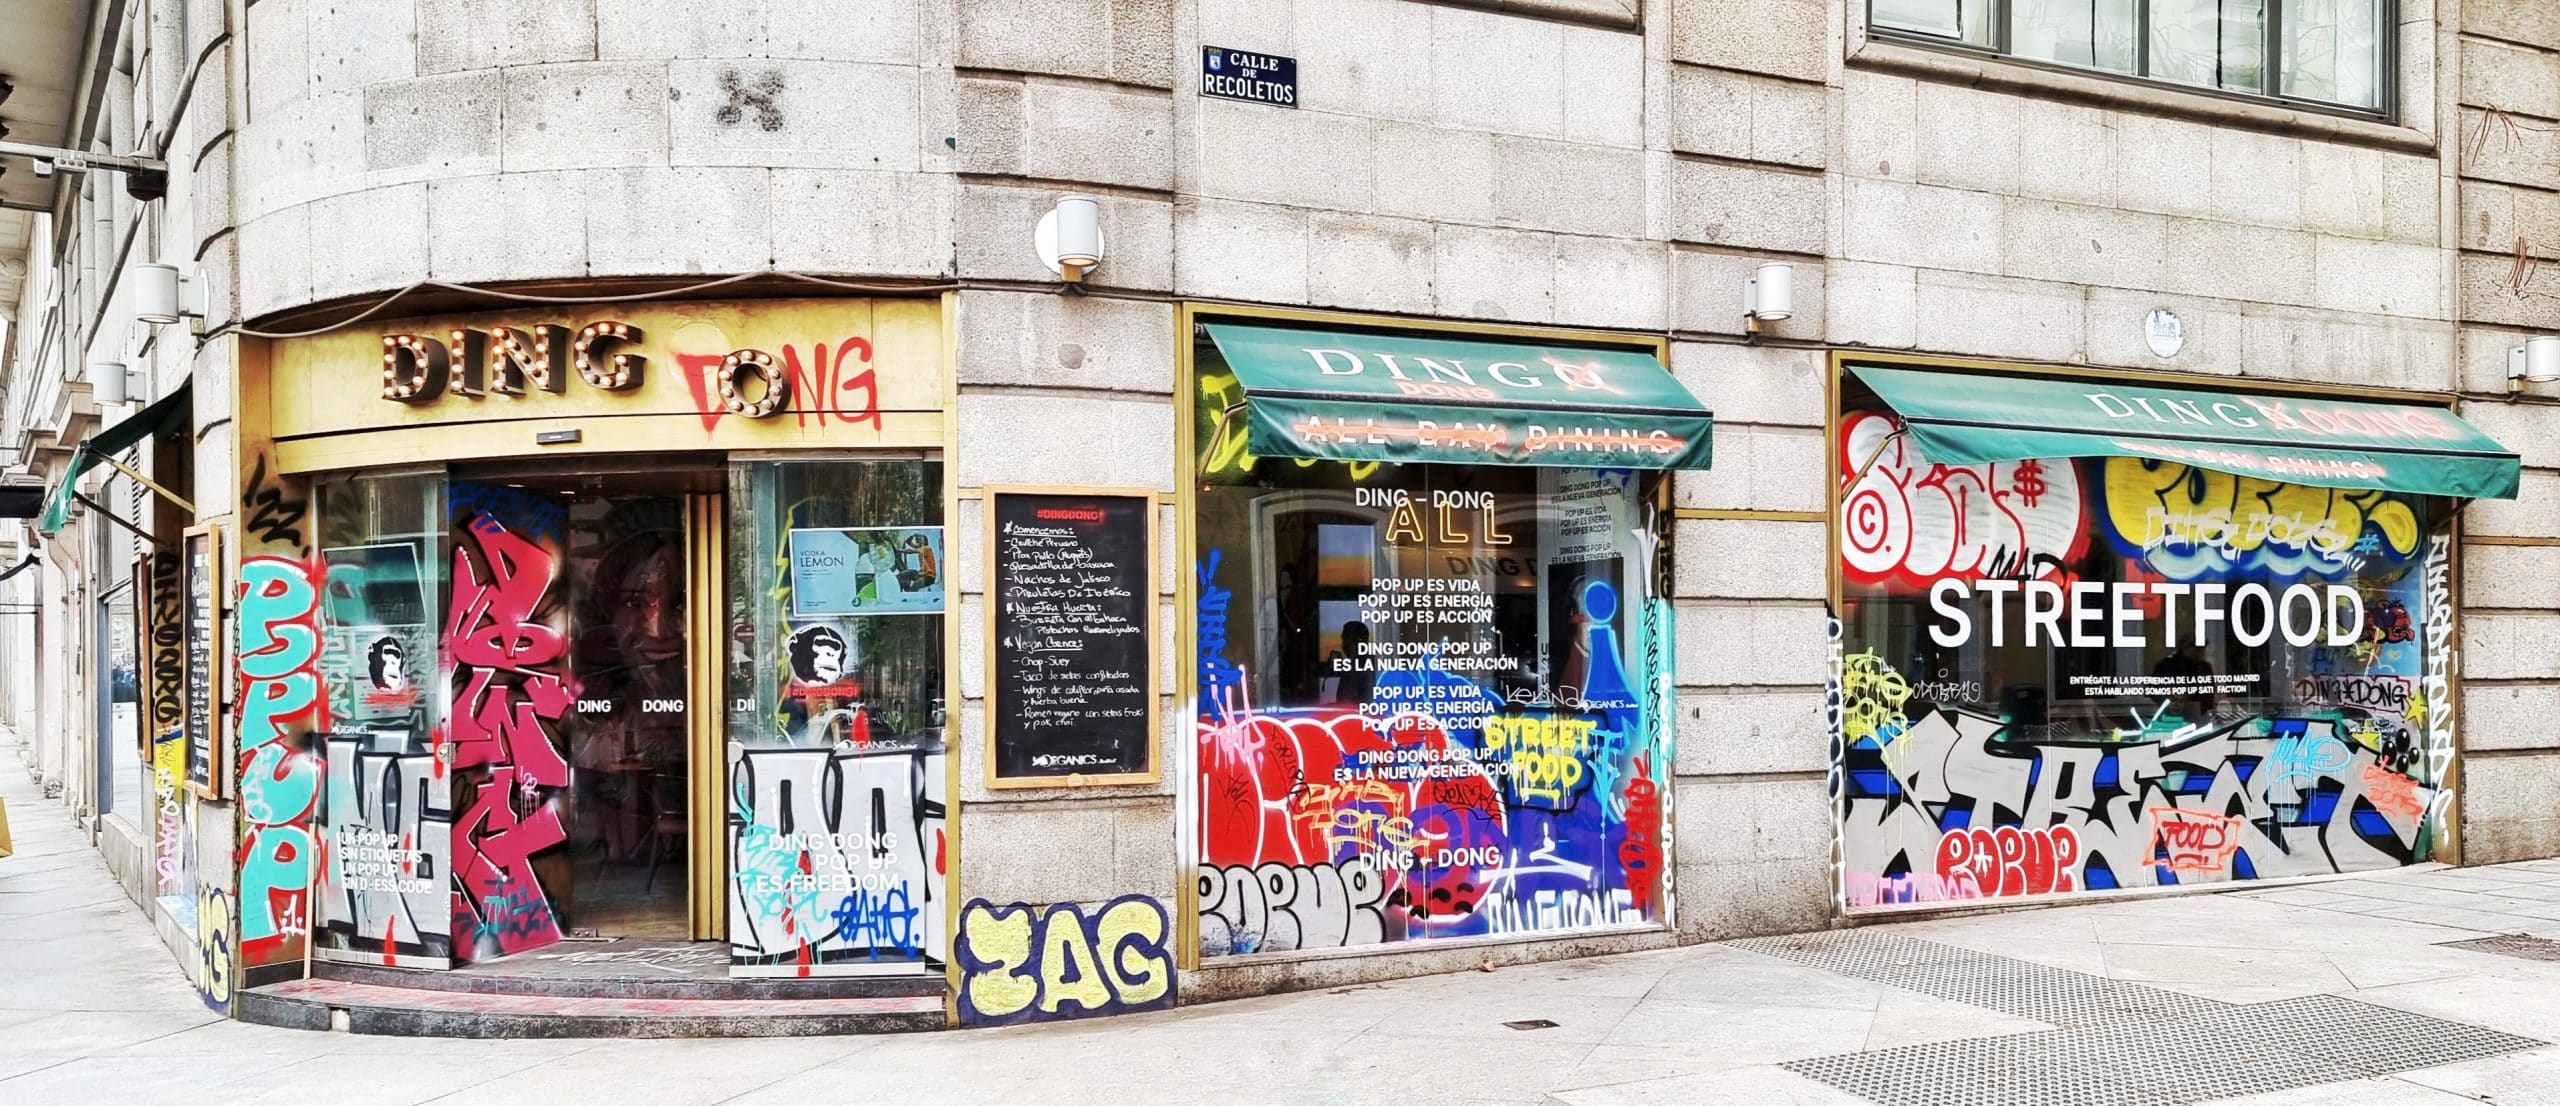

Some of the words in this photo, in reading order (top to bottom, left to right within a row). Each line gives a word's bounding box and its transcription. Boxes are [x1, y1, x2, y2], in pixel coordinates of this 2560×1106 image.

[1230, 52, 1279, 72] CALLE
[1242, 67, 1257, 79] DE
[1204, 73, 1293, 103] RECOLETOS
[382, 321, 648, 404] DING
[1304, 415, 1387, 445] ALL
[1417, 419, 1505, 450] DAY
[1527, 425, 1672, 455] DINING
[1355, 487, 1409, 508] DING
[1433, 490, 1495, 509] DONG
[1386, 499, 1512, 544] ALL
[800, 556, 845, 568] LEMON
[1013, 574, 1056, 585] Nachos
[1058, 574, 1072, 584] de
[1372, 578, 1401, 592] POP
[1404, 579, 1424, 592] UP
[1426, 579, 1445, 592] ES
[1448, 579, 1480, 592] VIDA
[1358, 595, 1388, 608] POP
[1391, 595, 1411, 608] UP
[1414, 595, 1432, 608] ES
[1434, 592, 1494, 608] ENERGÍA
[1361, 611, 1390, 624] POP
[1394, 611, 1414, 624] UP
[1416, 611, 1434, 624] ES
[1437, 608, 1492, 624] ACCIÓN
[1928, 577, 2364, 649] STREETFOOD
[1358, 642, 1394, 656] DING
[1396, 642, 1438, 656] DONG
[1442, 642, 1470, 655] POP
[1472, 642, 1493, 654] UP
[1333, 659, 1352, 672] ES
[1354, 659, 1374, 672] LA
[1377, 658, 1426, 672] NUEVA
[1428, 654, 1518, 671] GENERACIÓN
[1019, 670, 1044, 682] Taco
[2069, 675, 2112, 685] ENTRÉGATE
[2112, 676, 2119, 684] A
[2119, 676, 2130, 684] LA
[2176, 676, 2186, 684] DE
[2186, 676, 2196, 684] LA
[2198, 675, 2212, 684] QUE
[2213, 675, 2232, 684] TODO
[2233, 674, 2260, 682] MADRID
[1051, 686, 1062, 694] de
[1372, 686, 1402, 700] POP
[1405, 686, 1425, 700] UP
[1428, 686, 1446, 698] ES
[1448, 685, 1482, 698] VIDA
[2084, 686, 2103, 696] ESTÁ
[2104, 686, 2144, 696] HABLANDO
[2144, 686, 2172, 696] SOMOS
[2172, 686, 2187, 695] POP
[2188, 686, 2198, 695] UP
[578, 700, 612, 714] DING
[642, 699, 685, 714] DONG
[1359, 702, 1388, 716] POP
[1392, 702, 1412, 715] UP
[1414, 702, 1432, 714] ES
[1436, 698, 1495, 714] ENERGÍA
[1394, 718, 1414, 731] UP
[1417, 718, 1436, 730] ES
[1484, 714, 1597, 750] STREET
[1358, 750, 1394, 764] DING
[1398, 750, 1440, 764] DONG
[1442, 749, 1470, 762] POP
[1474, 748, 1494, 760] UP
[1334, 768, 1352, 782] ES
[1356, 768, 1376, 781] LA
[1378, 766, 1426, 780] NUEVA
[1430, 762, 1519, 778] GENERACIÓN
[340, 833, 357, 846] UN
[358, 832, 380, 846] POP
[382, 832, 398, 846] UP
[769, 833, 824, 852] DING
[830, 832, 898, 851] DONG
[359, 848, 423, 864] ETIQUETAS
[815, 853, 856, 871] POP
[868, 853, 898, 871] UP
[1359, 850, 1414, 872] DING
[1438, 847, 1501, 868] DONG
[342, 863, 358, 876] UN
[358, 863, 380, 876] POP
[383, 863, 398, 876] UP
[398, 879, 433, 895] CODE
[756, 874, 790, 894] ES
[790, 873, 899, 892] FREEDOM
